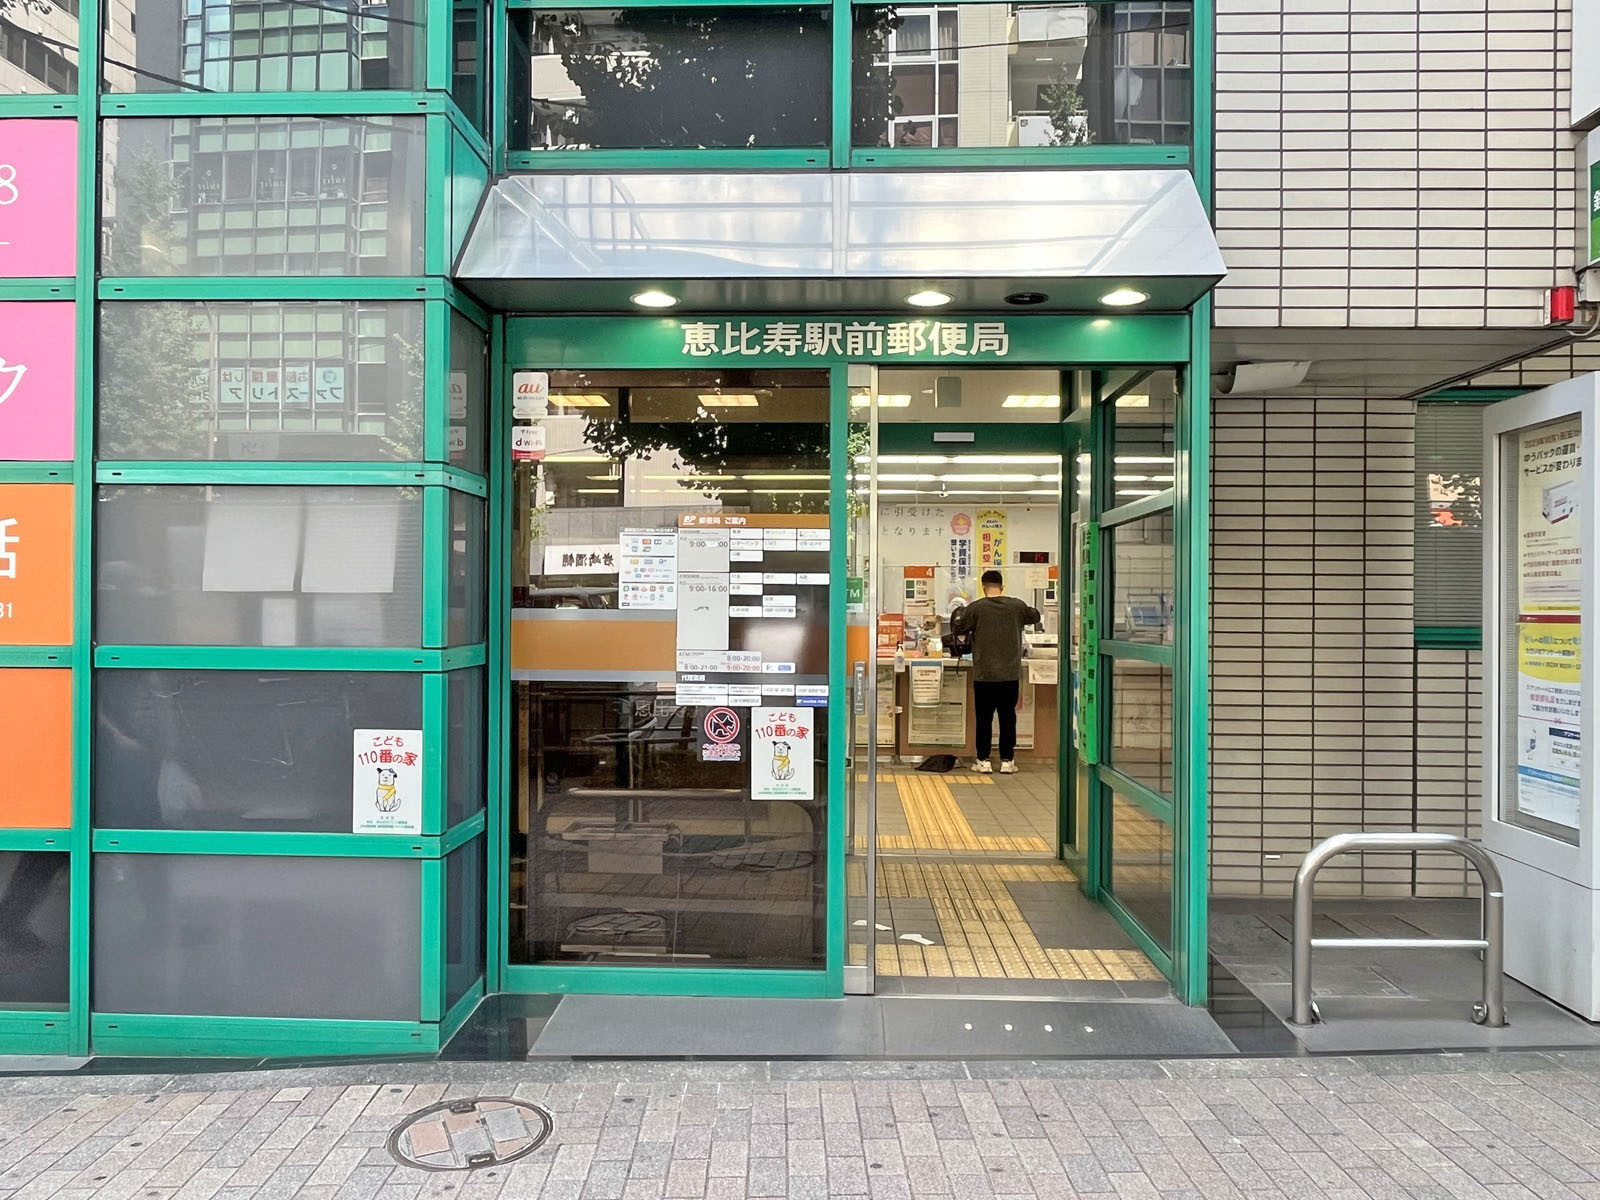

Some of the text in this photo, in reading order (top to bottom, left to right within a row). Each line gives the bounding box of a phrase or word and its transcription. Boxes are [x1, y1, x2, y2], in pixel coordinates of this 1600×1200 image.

[680, 321, 1009, 357] 恵比寿駅前郵便局
[518, 383, 544, 394] au
[724, 516, 747, 525] ご案内
[925, 567, 933, 577] 4
[768, 712, 797, 723] こども
[755, 724, 809, 740] 110番の家
[373, 735, 404, 747] こども
[358, 749, 418, 767] 110番の家
